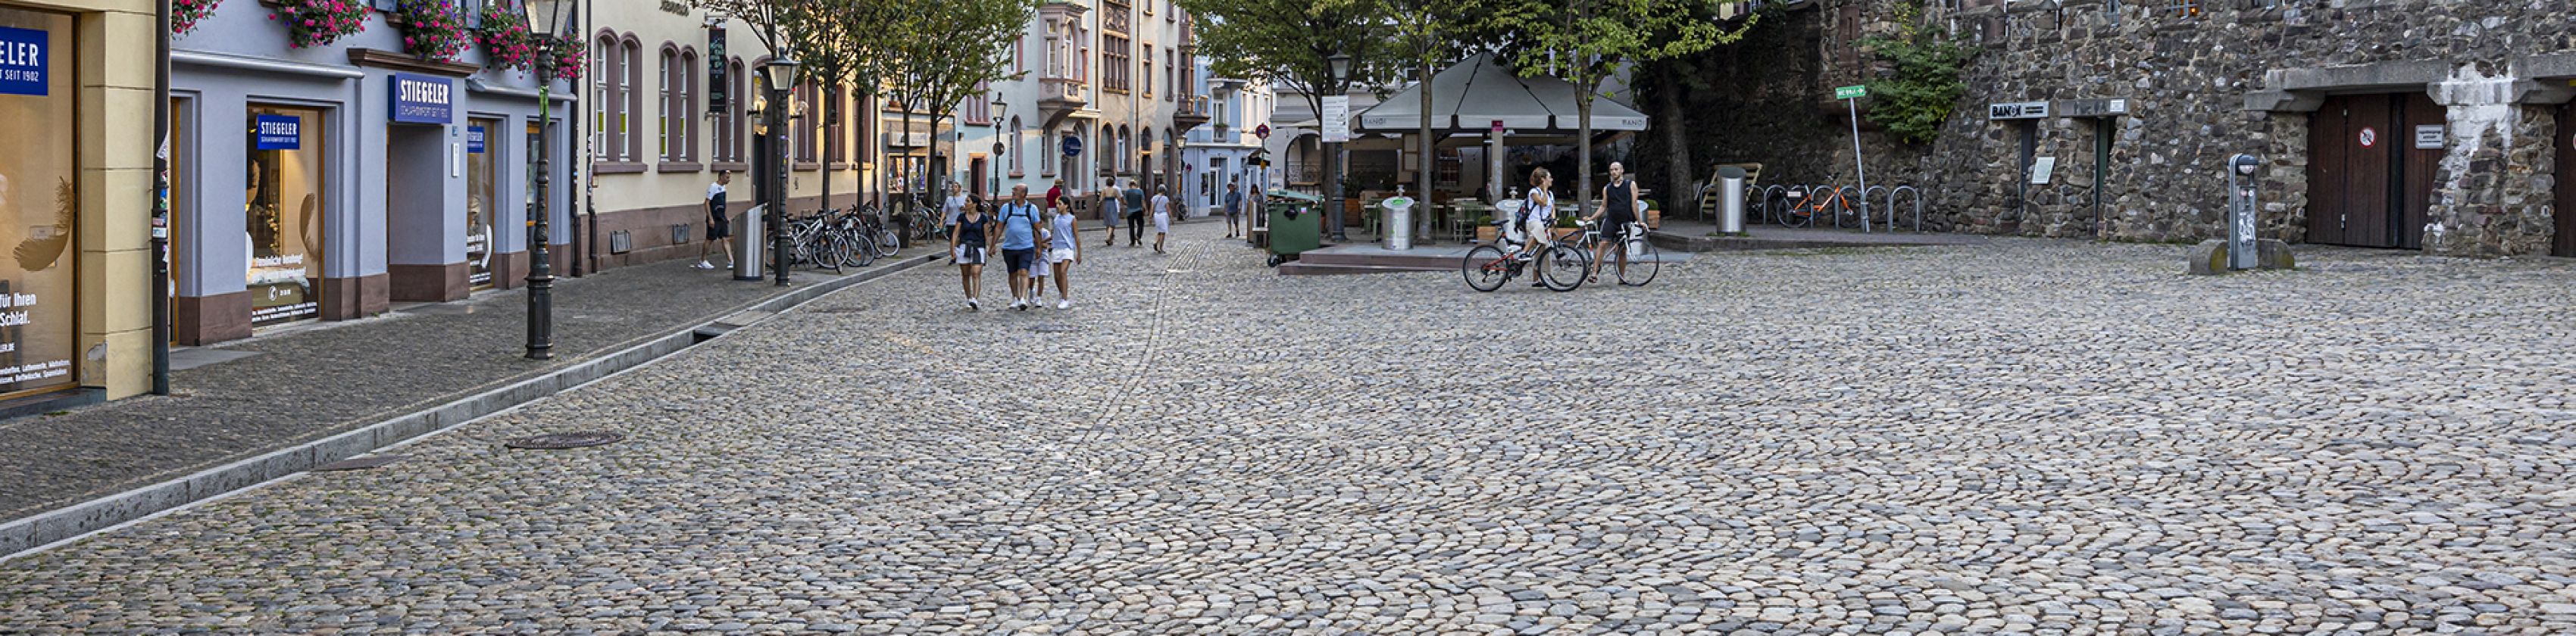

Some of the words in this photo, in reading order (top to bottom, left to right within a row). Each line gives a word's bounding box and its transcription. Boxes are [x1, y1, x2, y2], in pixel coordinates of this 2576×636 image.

[5, 69, 21, 80] SEIT
[400, 79, 449, 104] STIEGELER
[261, 121, 298, 135] STIEGELER
[14, 292, 37, 307] Ihren
